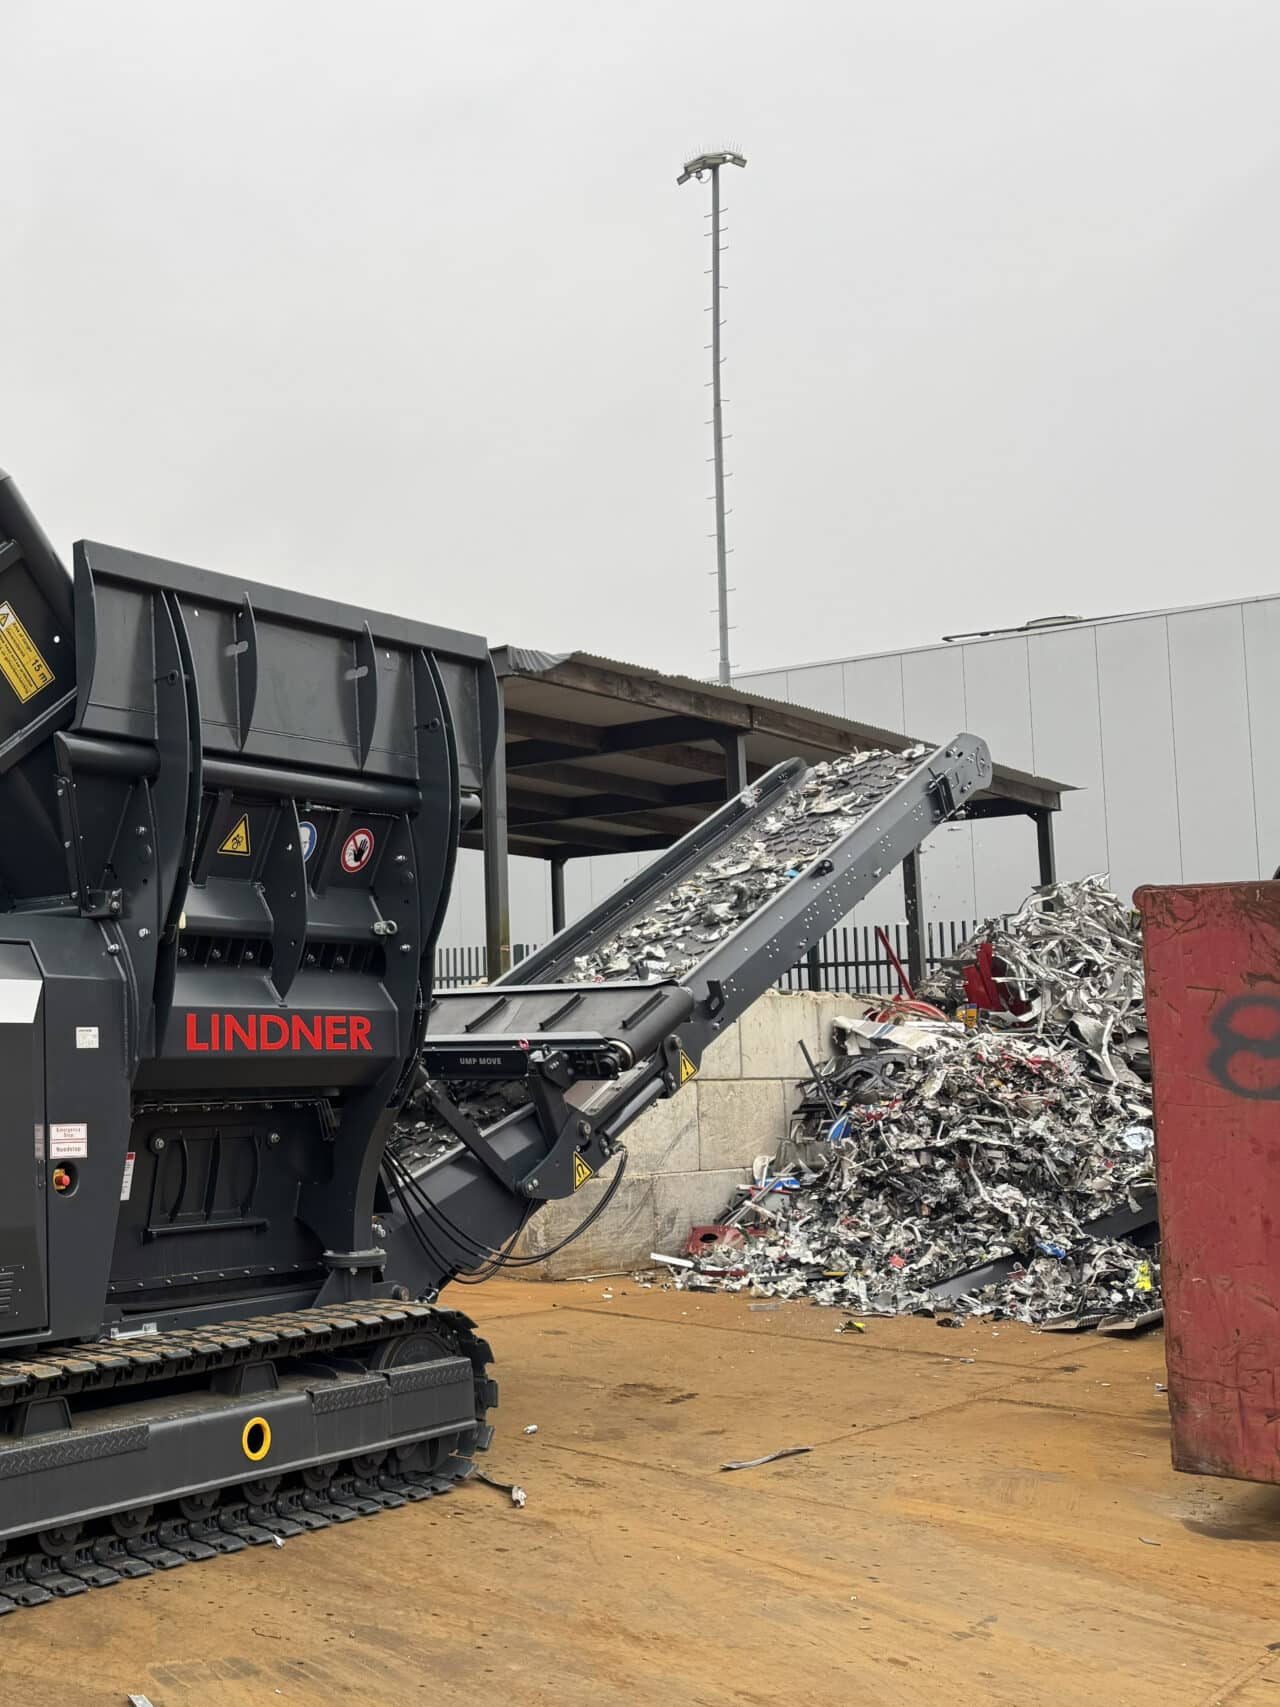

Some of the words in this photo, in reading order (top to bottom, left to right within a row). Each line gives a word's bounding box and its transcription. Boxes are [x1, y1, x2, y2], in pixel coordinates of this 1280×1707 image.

[31, 659, 43, 672] 15
[185, 1013, 373, 1051] LINDNER
[479, 1057, 502, 1065] MOVE
